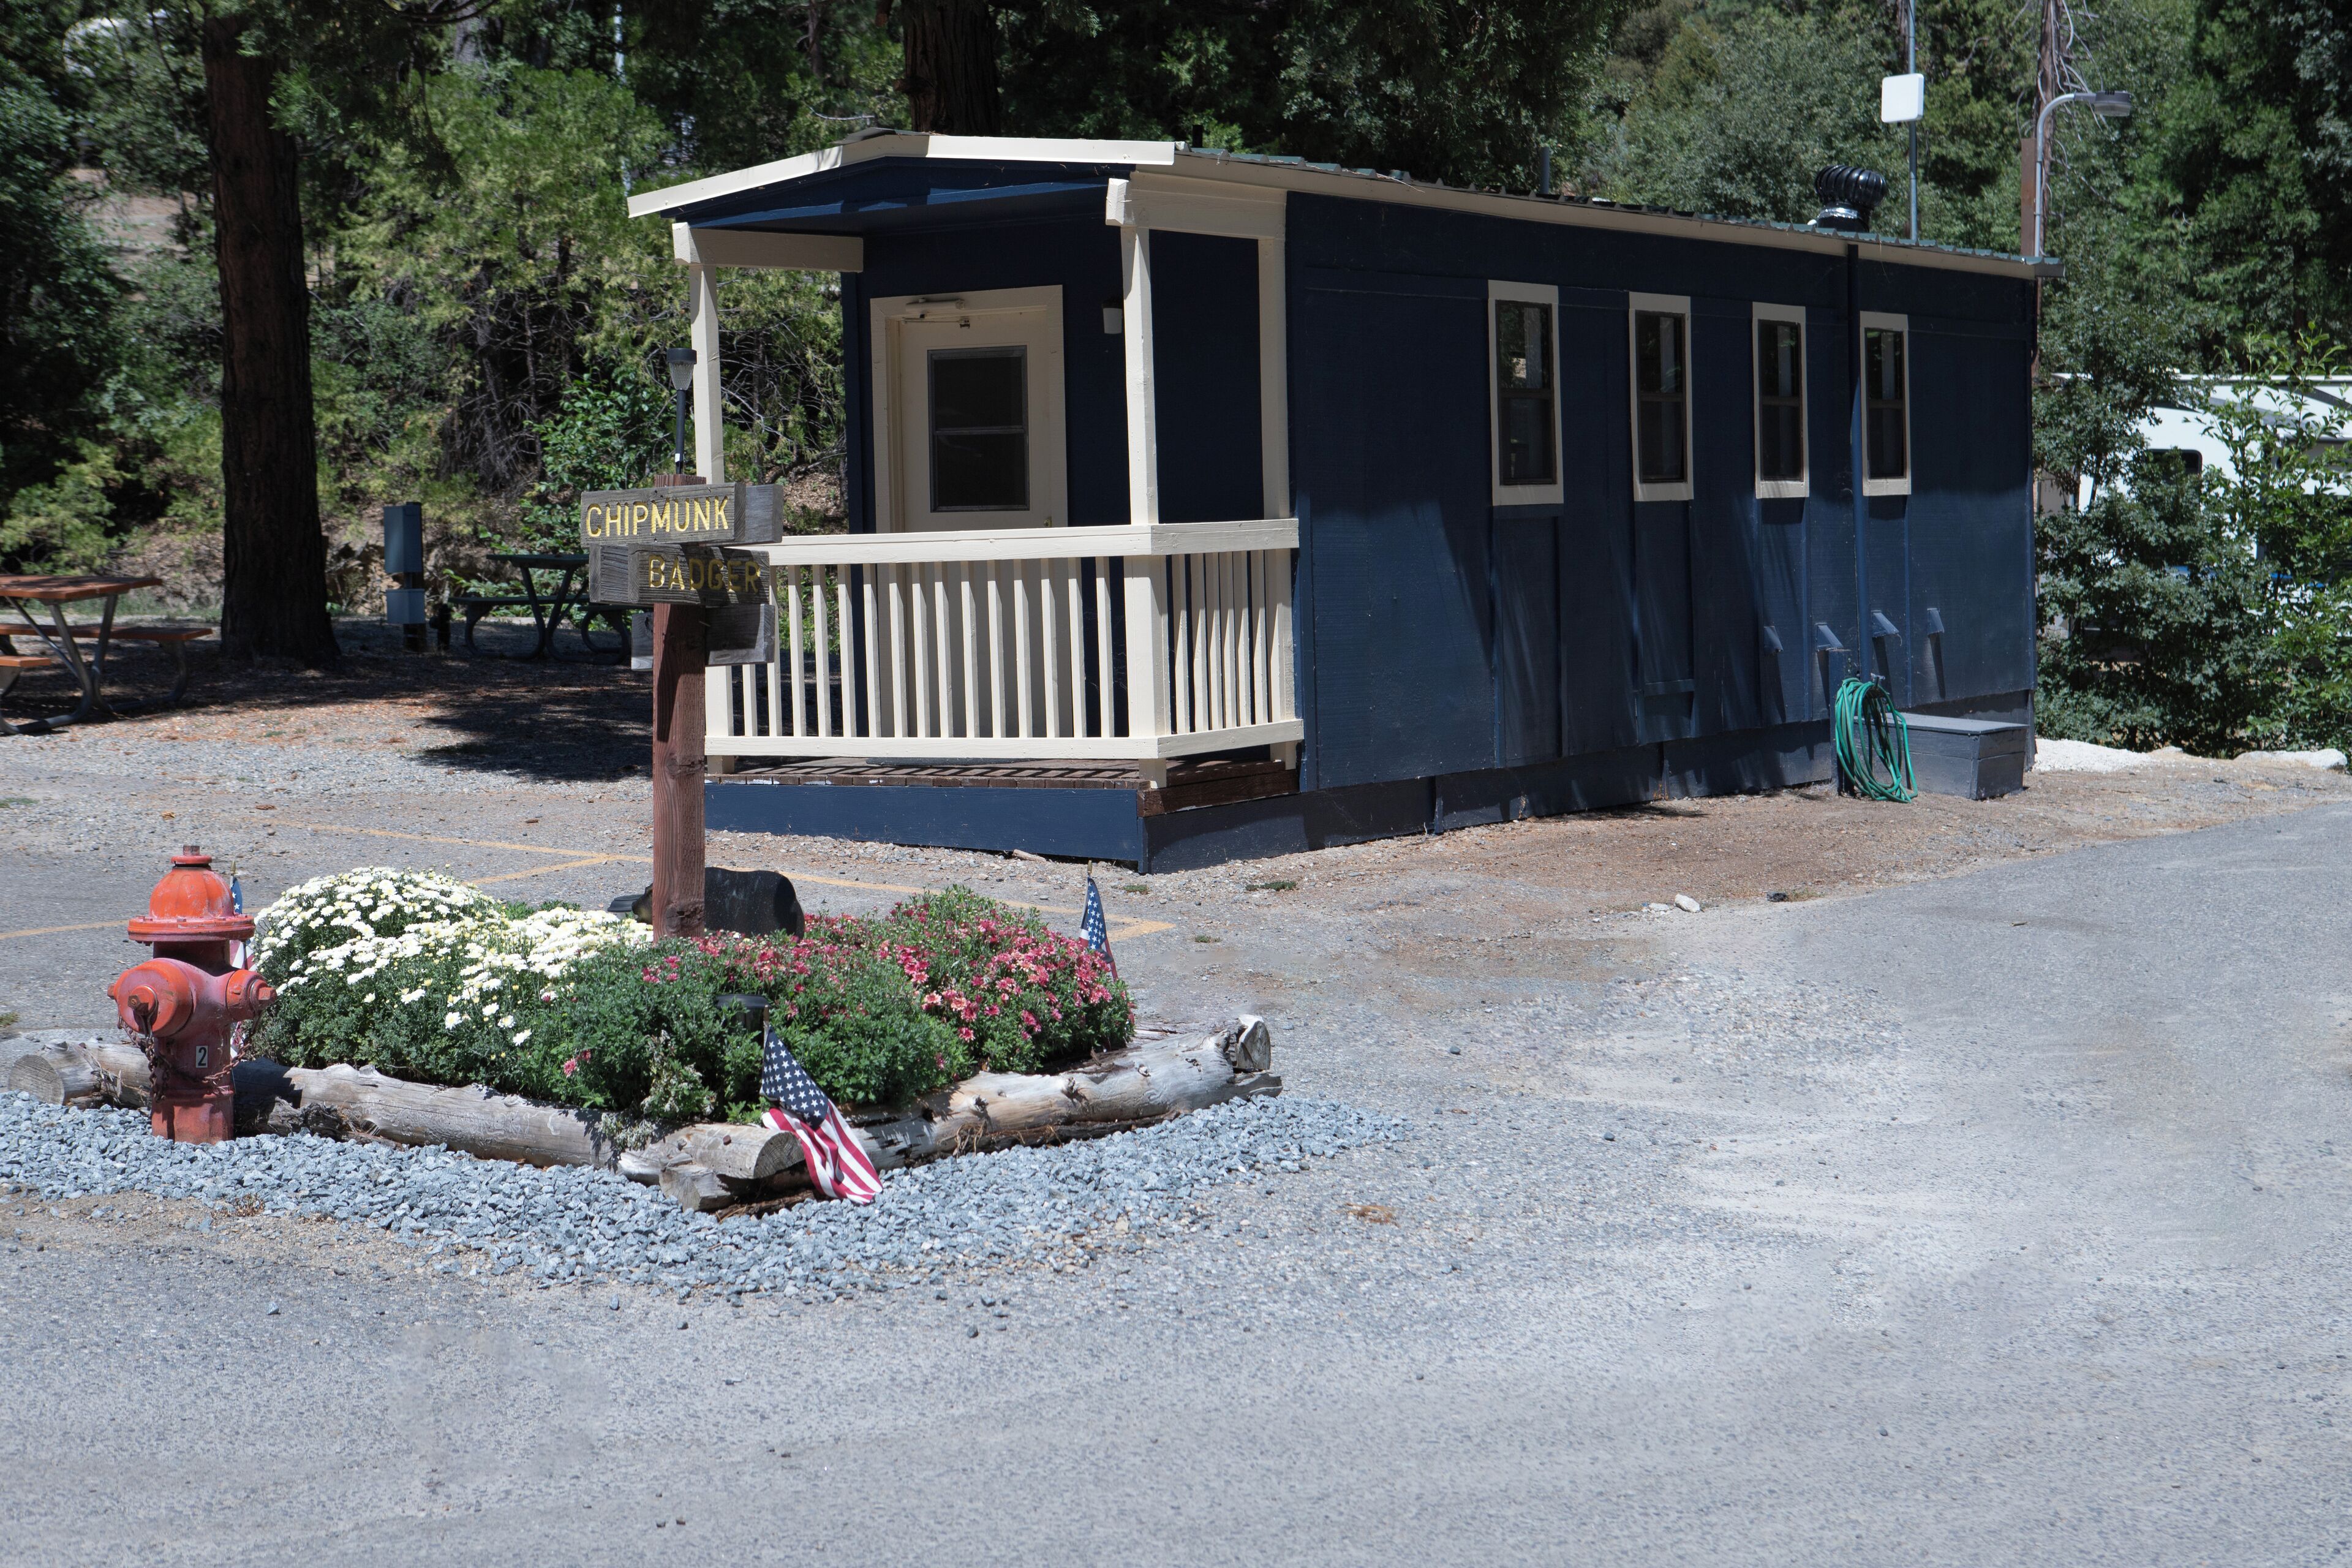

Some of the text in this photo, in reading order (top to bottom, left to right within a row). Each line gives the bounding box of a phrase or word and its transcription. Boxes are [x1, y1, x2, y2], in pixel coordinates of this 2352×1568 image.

[586, 495, 729, 538] CHIPMUNK
[648, 554, 761, 594] BADGER
[198, 1047, 207, 1066] 2
